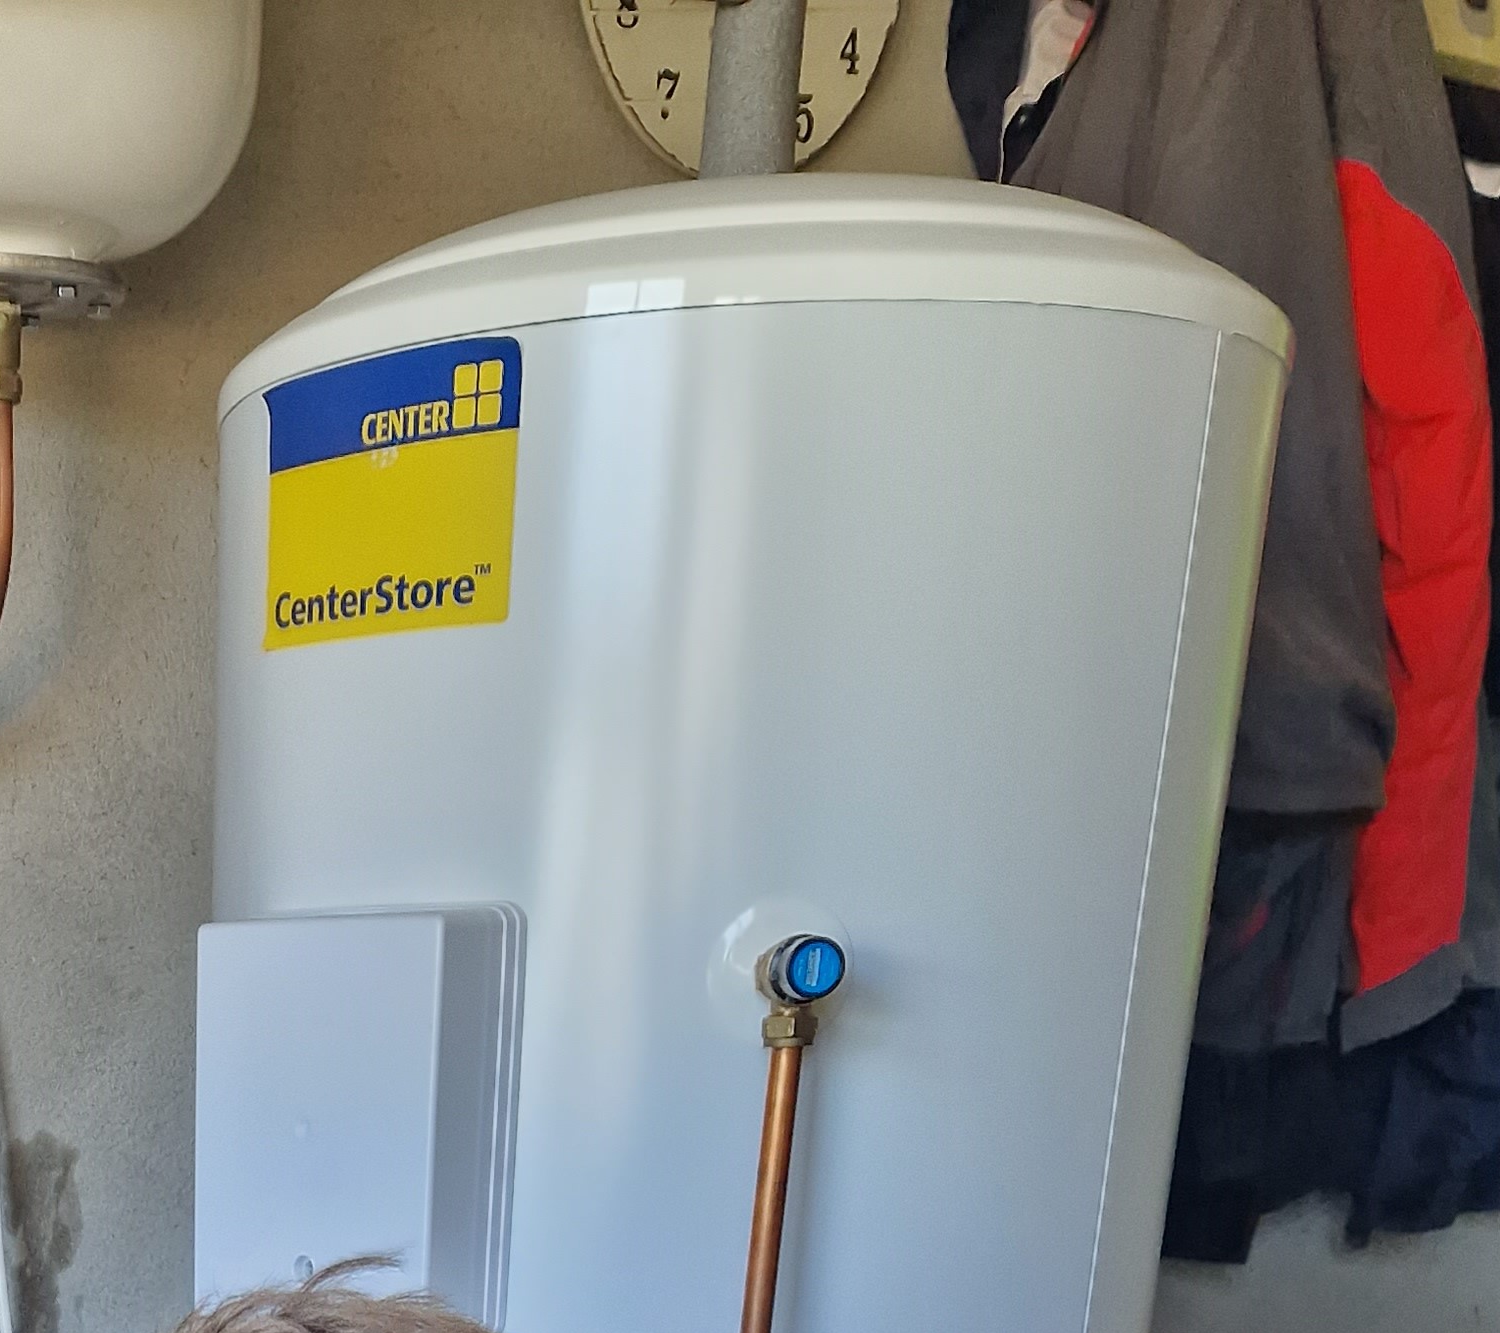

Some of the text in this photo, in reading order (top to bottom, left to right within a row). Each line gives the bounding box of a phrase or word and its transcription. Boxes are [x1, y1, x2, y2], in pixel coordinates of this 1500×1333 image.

[839, 27, 860, 74] 4
[656, 67, 680, 120] 7
[361, 400, 449, 445] CENTER
